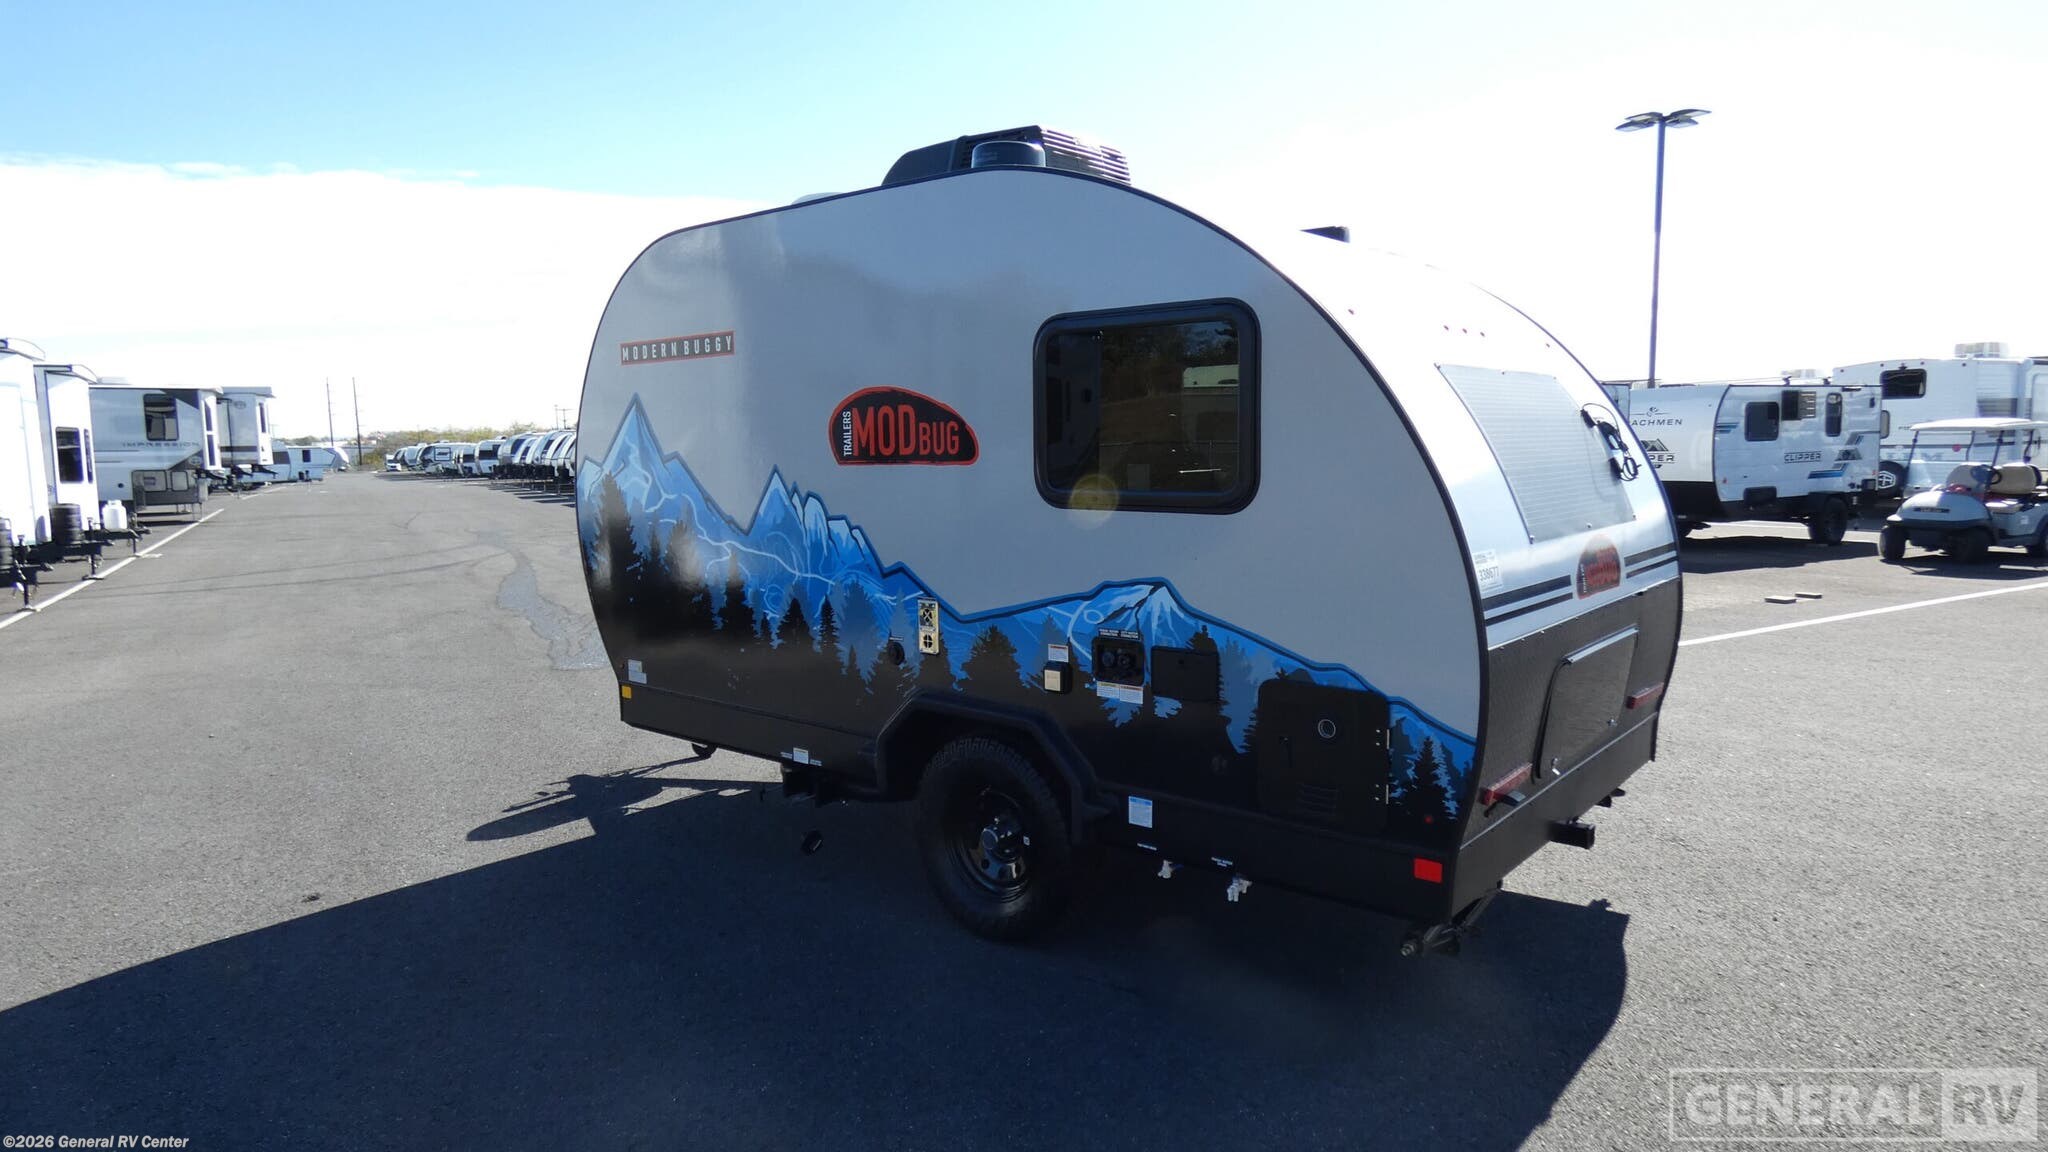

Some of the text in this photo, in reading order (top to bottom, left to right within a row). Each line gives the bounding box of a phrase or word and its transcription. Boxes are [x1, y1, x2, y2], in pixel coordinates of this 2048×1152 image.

[621, 335, 732, 361] MODERN BUGGY
[1631, 418, 1683, 427] ACHMEN
[841, 410, 853, 457] TRAILERS
[1784, 452, 1822, 462] CLIPPER
